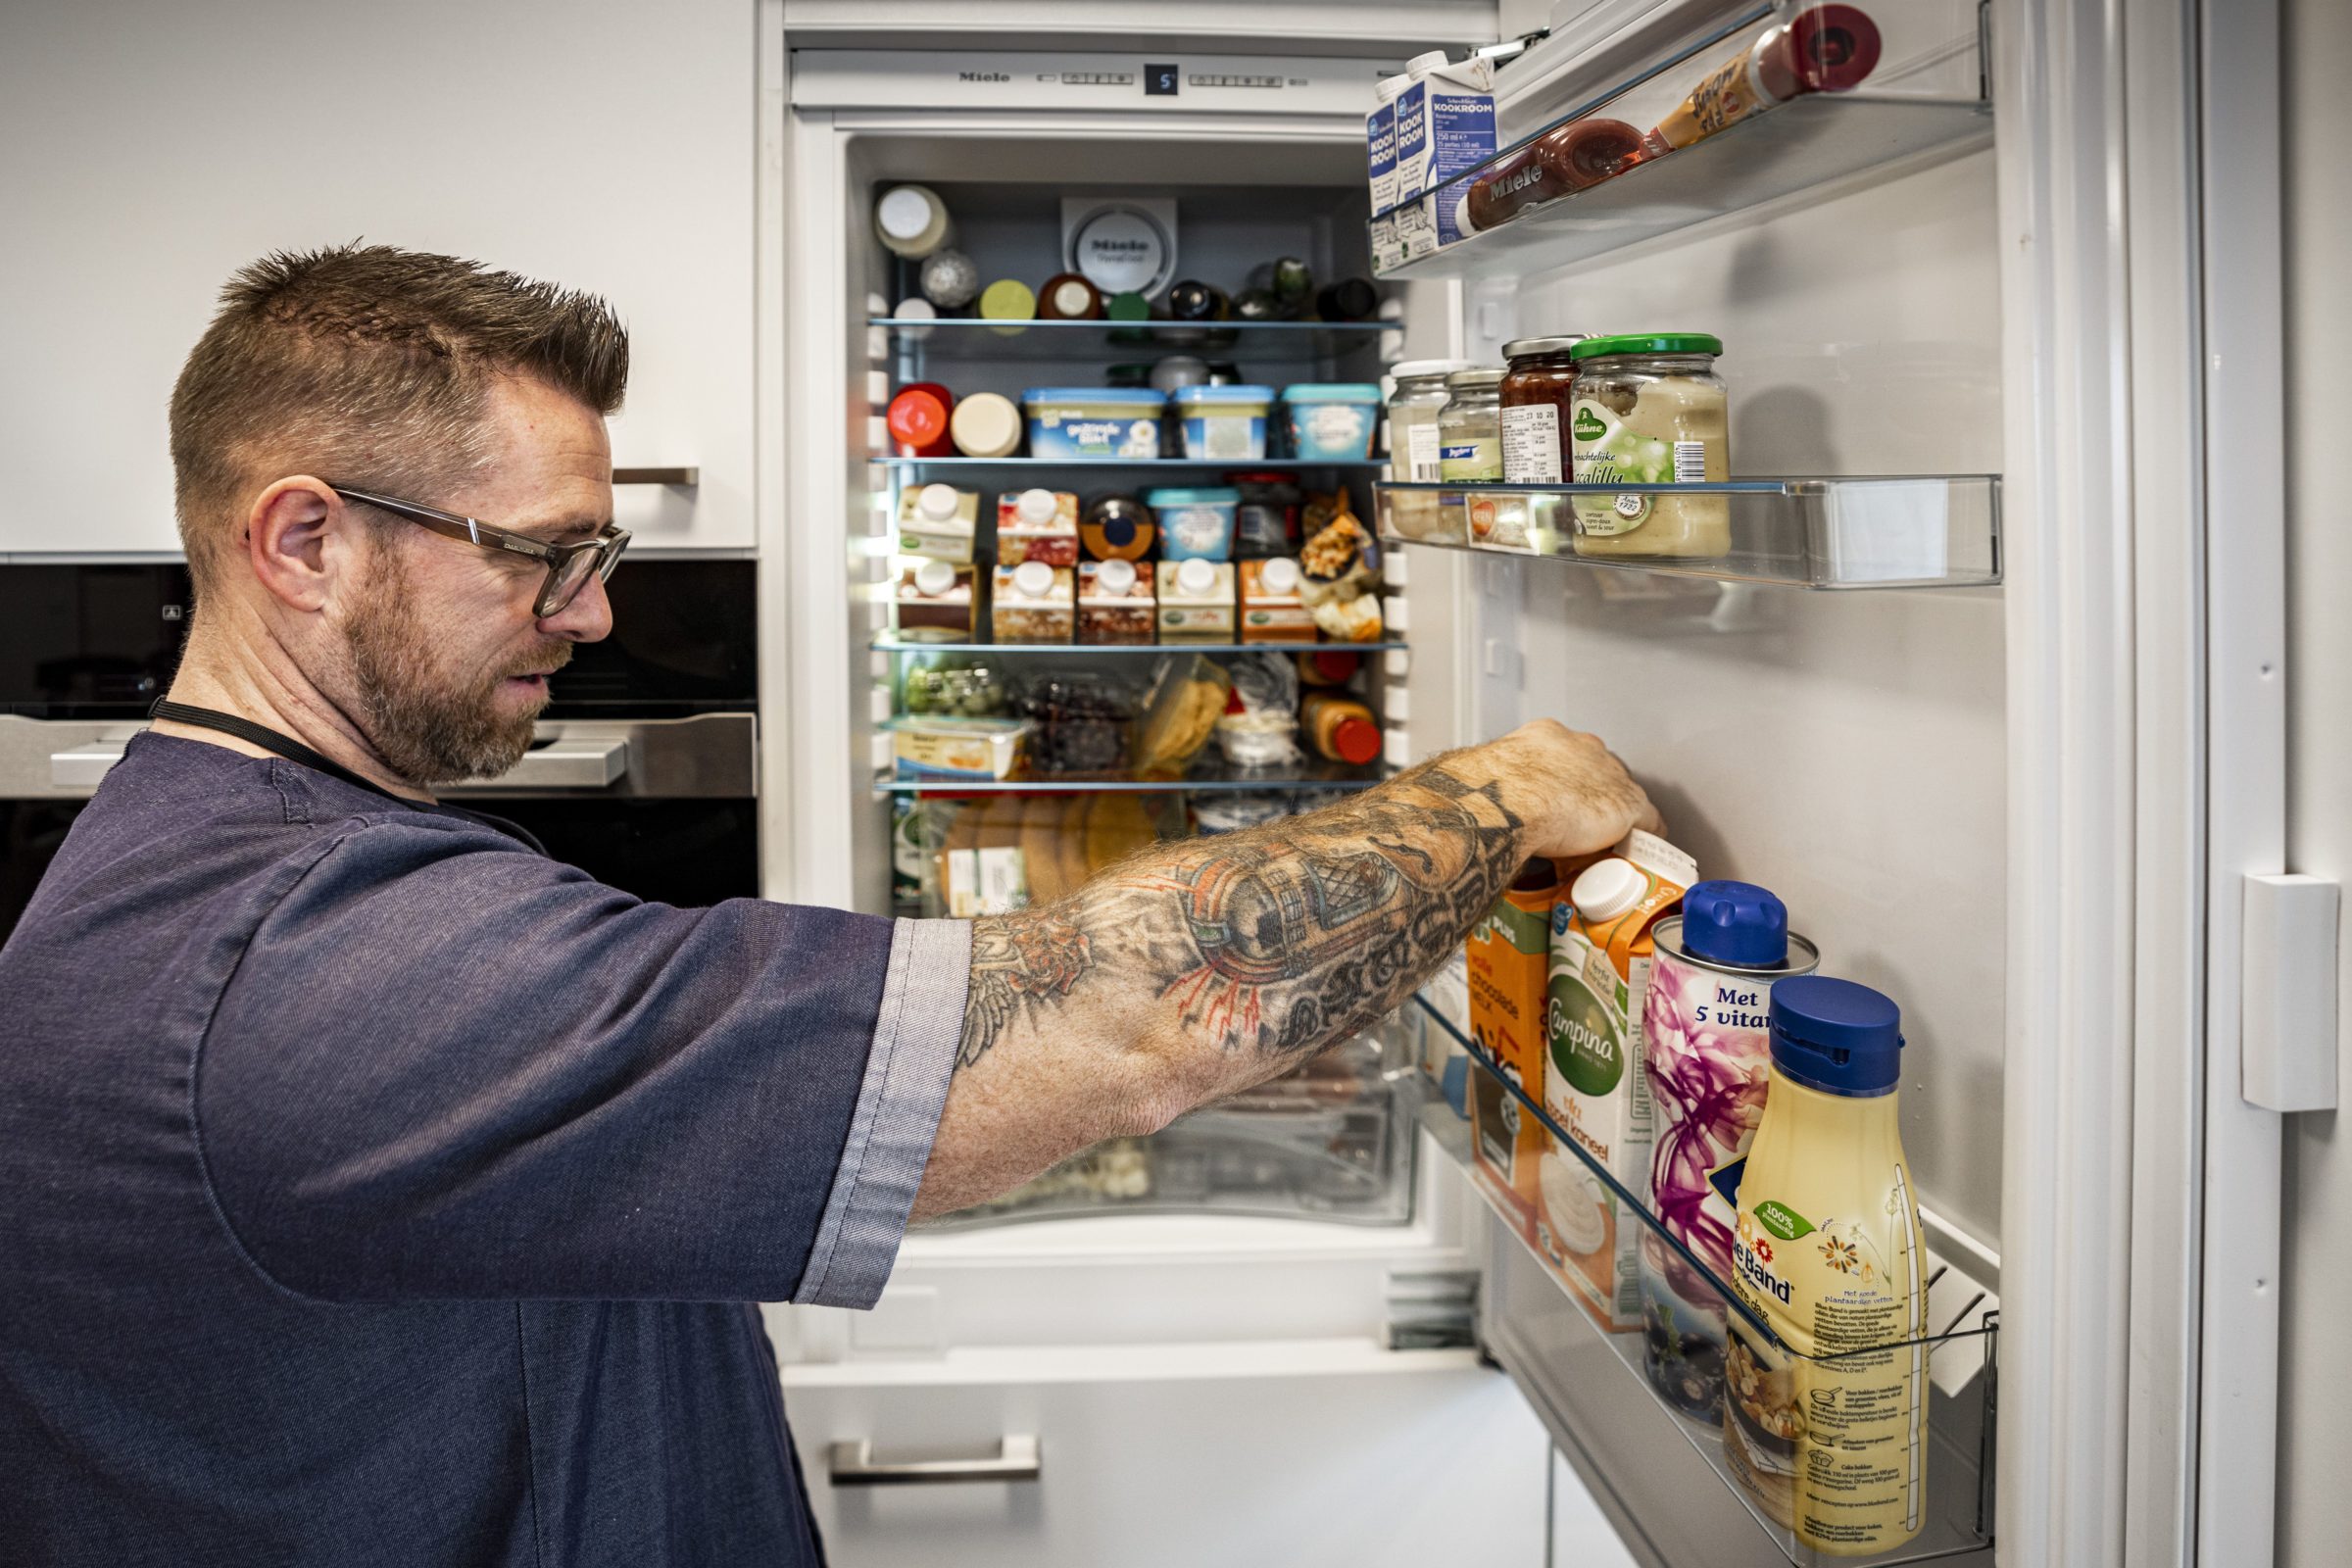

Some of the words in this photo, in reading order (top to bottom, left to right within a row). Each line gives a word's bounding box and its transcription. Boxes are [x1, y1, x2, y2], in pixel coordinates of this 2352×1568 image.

[959, 72, 1010, 82] Miele
[1434, 103, 1493, 113] KOOKROOM
[1398, 111, 1423, 134] KOOK
[1370, 131, 1395, 153] KOOK
[1398, 124, 1424, 149] ROOM
[1370, 145, 1396, 168] ROOM
[1490, 165, 1543, 202] Miele
[1575, 423, 1603, 433] Kühne
[1717, 988, 1758, 1006] Met
[1695, 1005, 1709, 1022] 5
[1548, 998, 1613, 1061] Campina
[1570, 1117, 1608, 1162] kaneel
[1767, 1203, 1794, 1229] 100%
[1745, 1248, 1790, 1305] Band
